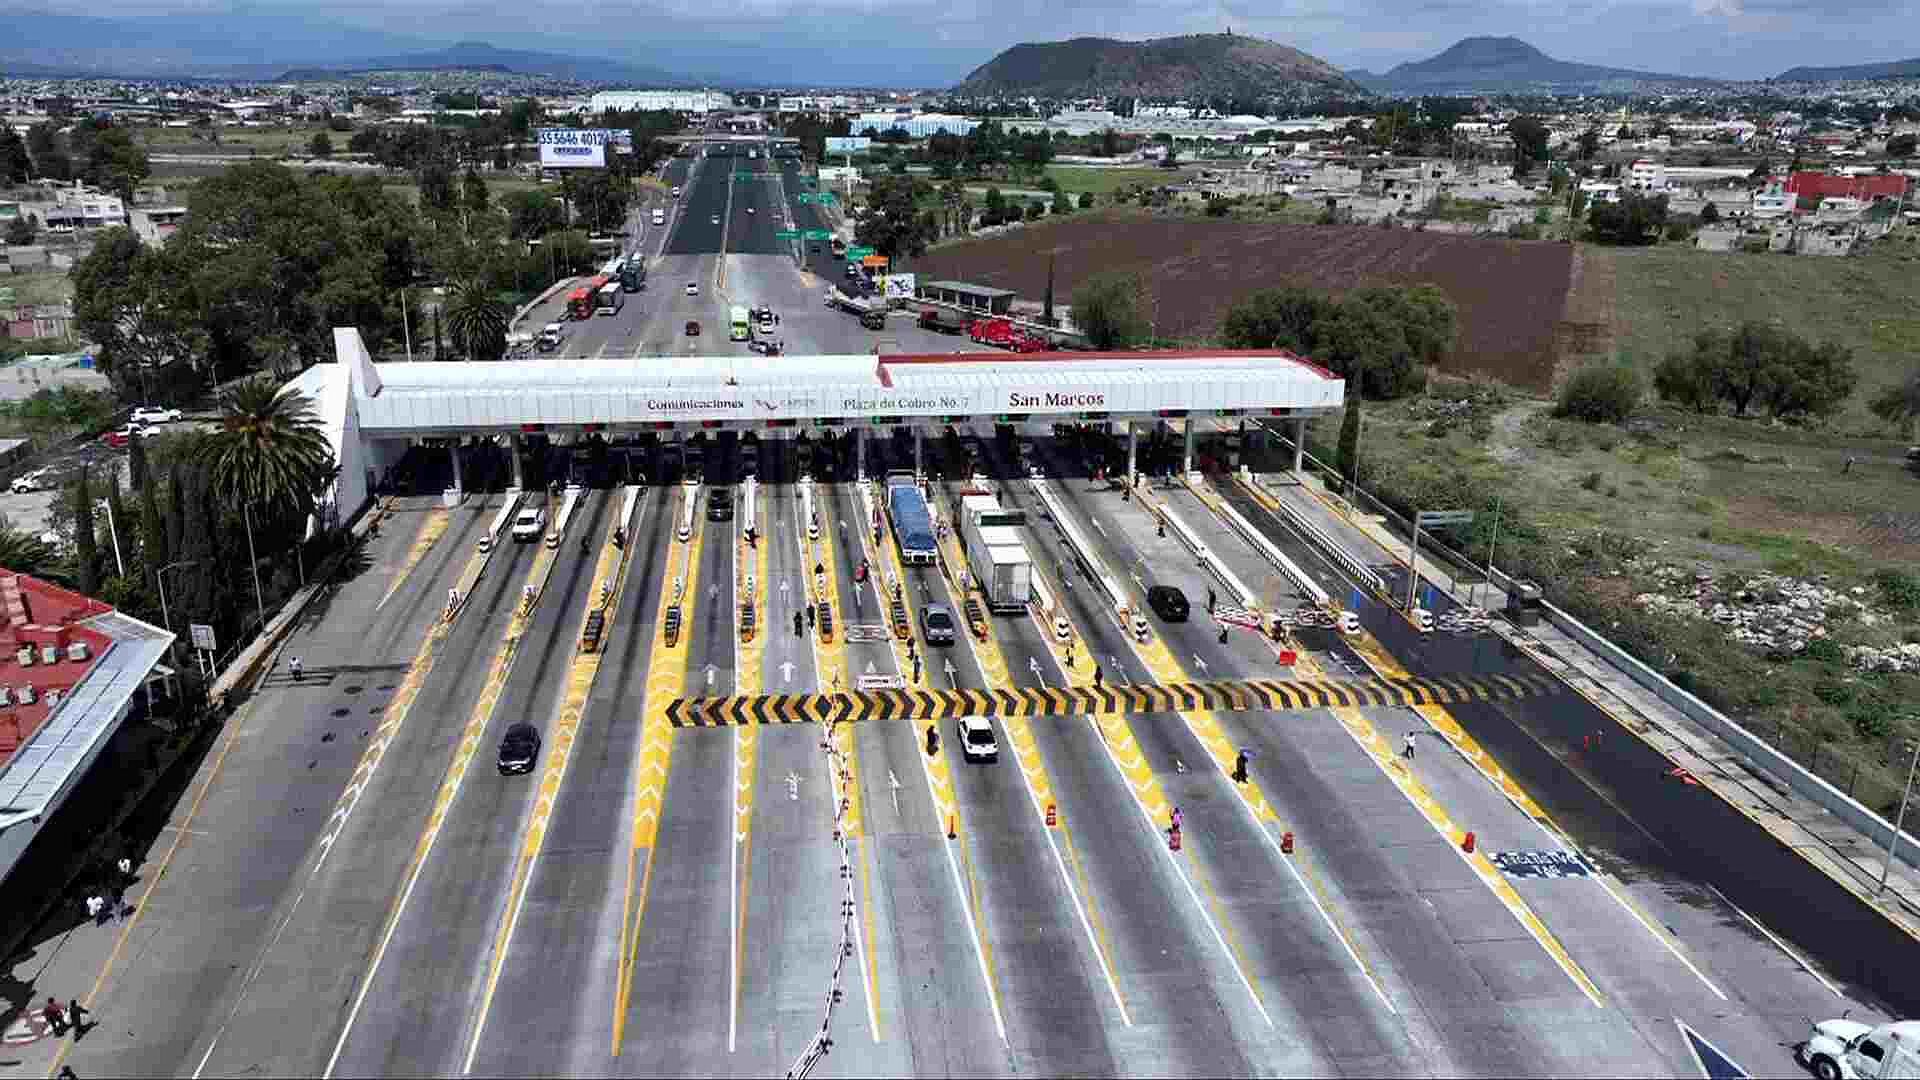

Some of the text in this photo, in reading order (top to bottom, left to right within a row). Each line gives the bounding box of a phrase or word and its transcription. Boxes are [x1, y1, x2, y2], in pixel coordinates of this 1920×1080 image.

[647, 399, 744, 410] Comunicaciones
[843, 398, 875, 409] Plaza
[898, 396, 936, 408] Cobro
[1009, 391, 1105, 407] San Marcos
